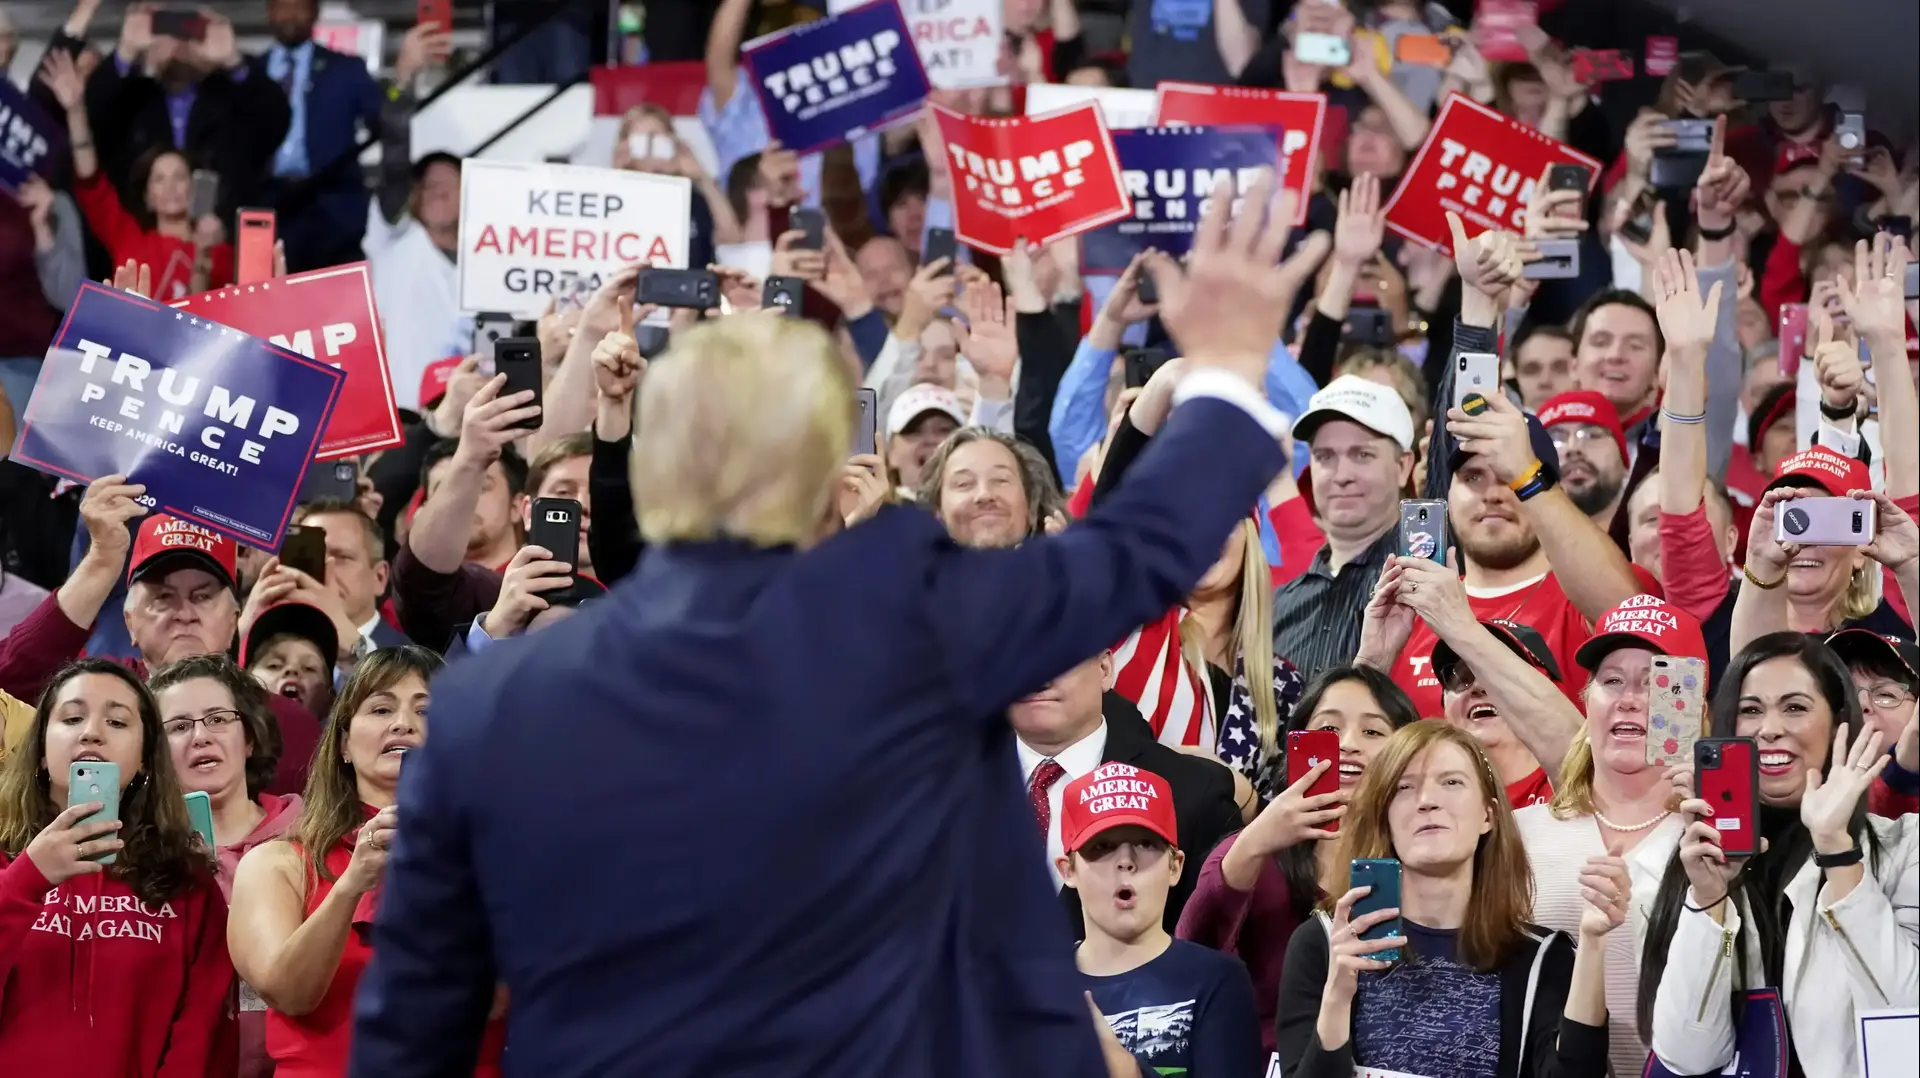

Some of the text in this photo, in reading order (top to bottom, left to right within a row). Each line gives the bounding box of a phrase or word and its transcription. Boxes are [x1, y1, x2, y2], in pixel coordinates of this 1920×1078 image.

[914, 16, 991, 42] RICA
[764, 30, 900, 98] TRUMP
[928, 48, 973, 69] AT!
[948, 140, 1094, 185] TRUMP
[1440, 138, 1537, 204] TRU
[965, 168, 1086, 205] PENCE
[1436, 172, 1527, 228] PENC
[528, 189, 623, 218] KEEP
[474, 224, 671, 264] AMERICA
[77, 338, 299, 439] TRUMP
[80, 382, 266, 465] PENCE
[89, 414, 239, 476] KEEP AMERICA GREAT!
[1781, 451, 1851, 473] MAKE AMERICA
[1783, 460, 1845, 479] GREAT AGAIN
[161, 533, 214, 551] GREAT
[1619, 594, 1666, 609] KEEP
[1604, 609, 1678, 631] AMERICA
[1608, 620, 1666, 637] GREAT
[1093, 763, 1139, 782] KEEP
[1080, 779, 1158, 805] AMERICA
[1089, 795, 1149, 814] GREAT
[31, 911, 163, 943] EAT AGAIN
